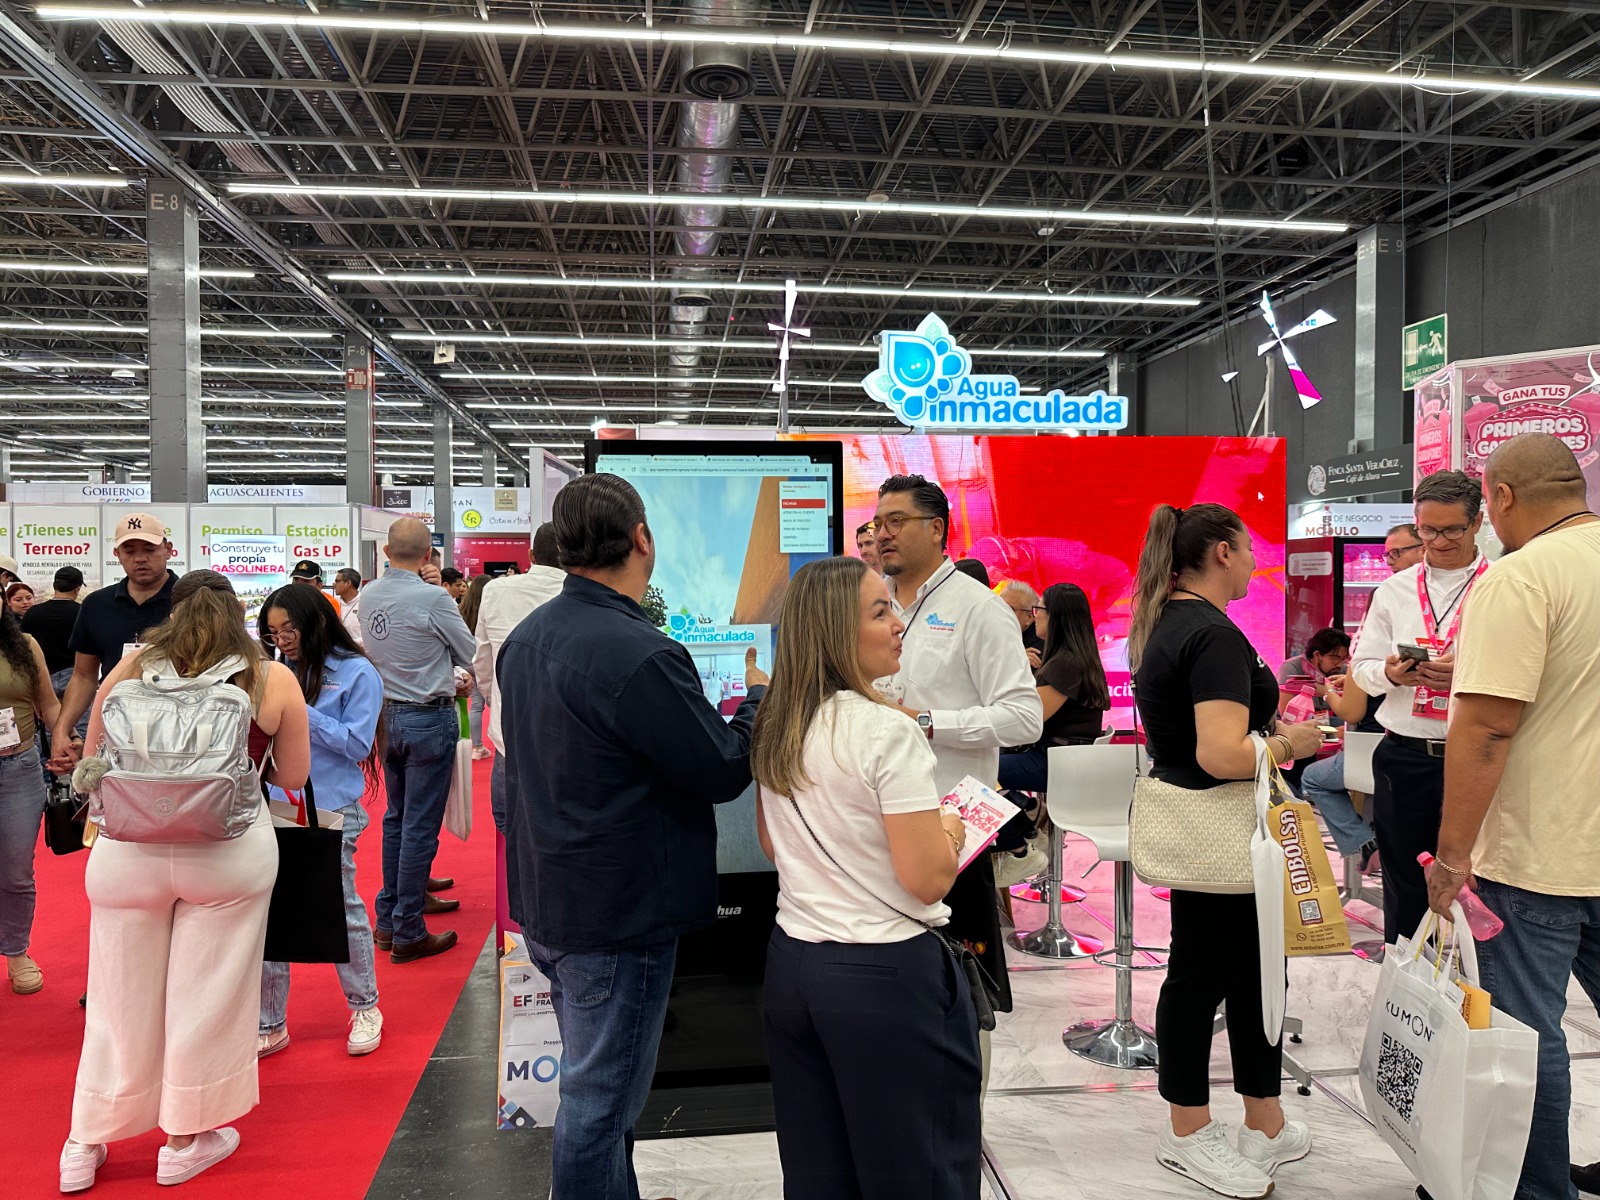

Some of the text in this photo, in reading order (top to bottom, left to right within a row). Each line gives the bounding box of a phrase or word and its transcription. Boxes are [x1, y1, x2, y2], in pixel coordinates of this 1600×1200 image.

[957, 377, 1017, 400] Agua
[1502, 387, 1566, 402] GANA TUS
[929, 394, 1122, 423] inmaculada
[1481, 416, 1584, 439] PRIMEROS
[82, 485, 145, 497] GOBIERNO
[210, 487, 304, 497] AGUASCALIENTES
[1333, 514, 1344, 523] DE
[1345, 514, 1383, 523] NEGOCIO
[16, 524, 74, 539] ¿Tienes
[78, 526, 97, 537] un
[201, 524, 263, 537] Permiso
[286, 524, 349, 537] Estación
[312, 537, 322, 545] de
[23, 543, 91, 555] Terreno?
[211, 543, 271, 555] Construye
[273, 545, 285, 553] tu
[293, 545, 342, 557] Gas LP
[228, 554, 266, 565] propia
[211, 564, 286, 573] GASOLINERA
[693, 625, 715, 634] Agua
[684, 630, 755, 643] inmaculada
[970, 805, 1002, 829] HORA
[968, 815, 993, 835] ROSA
[1314, 885, 1321, 893] LA
[513, 991, 551, 1008] EF EXP
[1385, 997, 1434, 1043] KUMON
